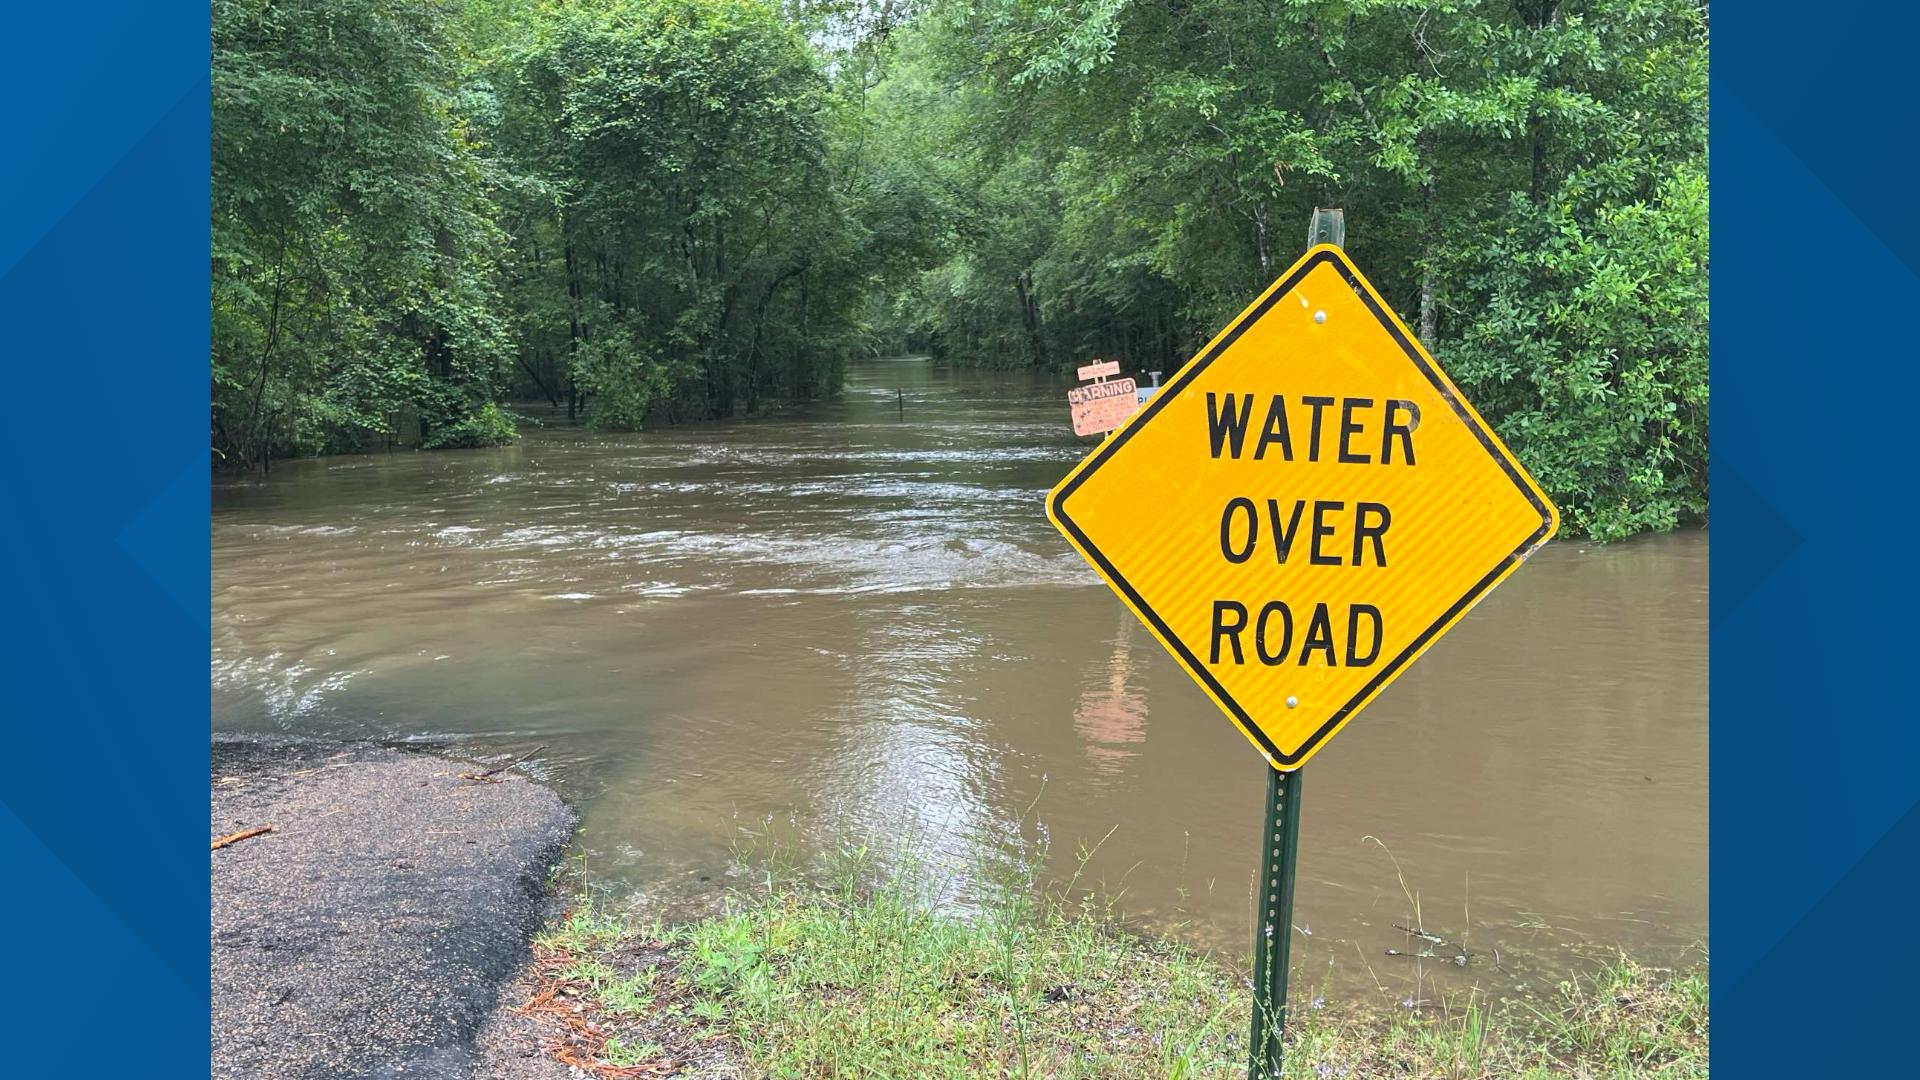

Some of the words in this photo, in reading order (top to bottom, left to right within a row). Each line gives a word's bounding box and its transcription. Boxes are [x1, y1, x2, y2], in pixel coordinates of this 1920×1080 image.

[1207, 393, 1420, 466] WATER
[1221, 497, 1391, 568] OVER
[1210, 601, 1382, 667] ROAD
